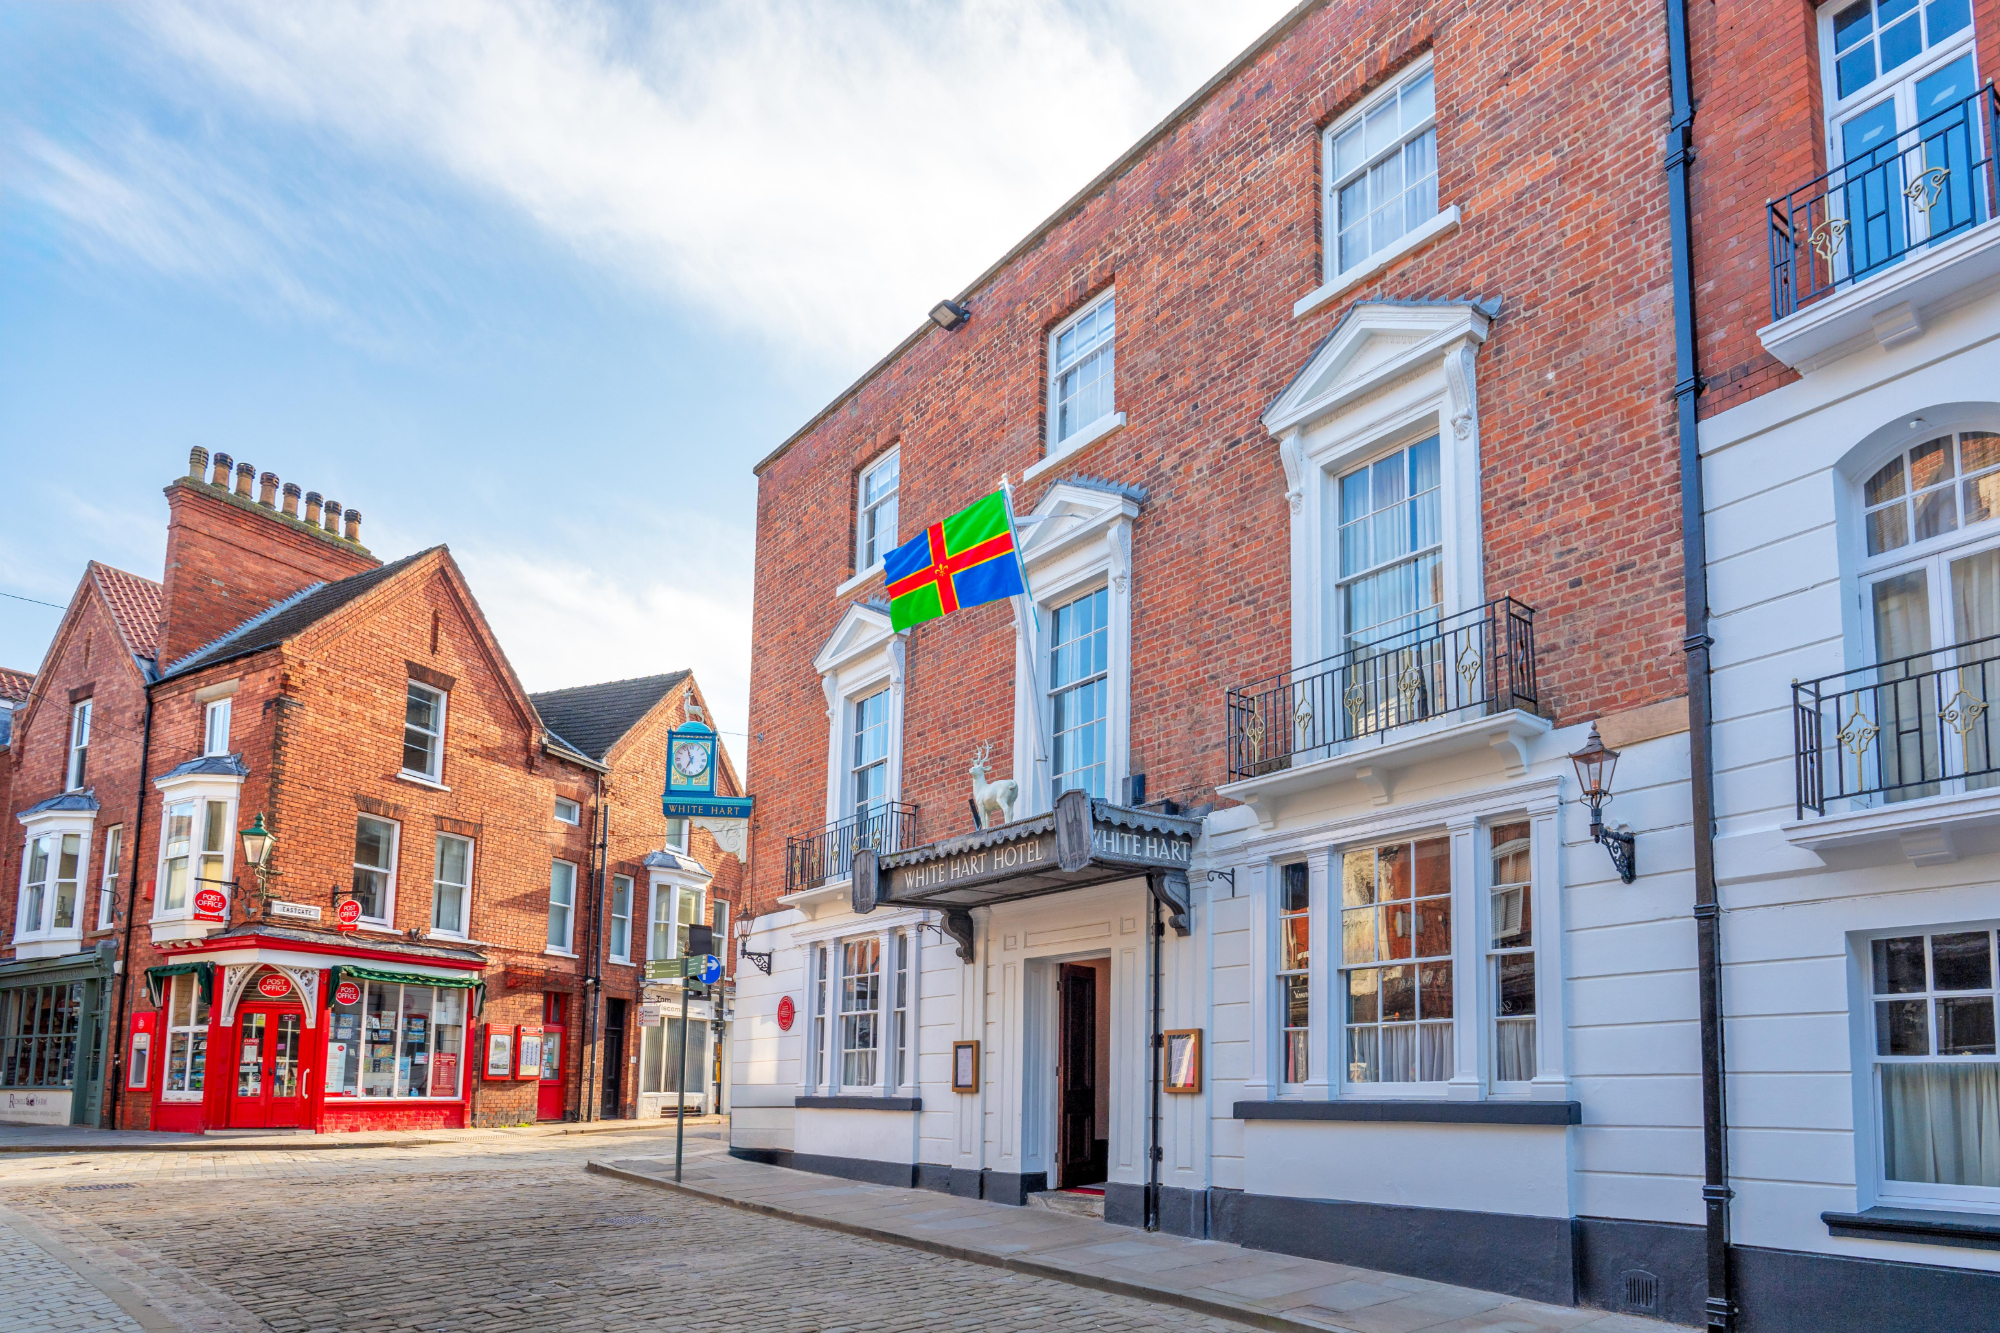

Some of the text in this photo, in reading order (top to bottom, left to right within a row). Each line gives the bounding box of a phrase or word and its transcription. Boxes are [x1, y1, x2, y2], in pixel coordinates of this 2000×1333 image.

[669, 804, 740, 815] WHITE HART
[1145, 836, 1191, 862] HART
[904, 840, 1044, 889] WHITE HART HOTEL
[202, 893, 221, 902] POST
[197, 900, 223, 909] OFFICE
[343, 904, 357, 912] POST
[340, 910, 357, 918] OFFICE
